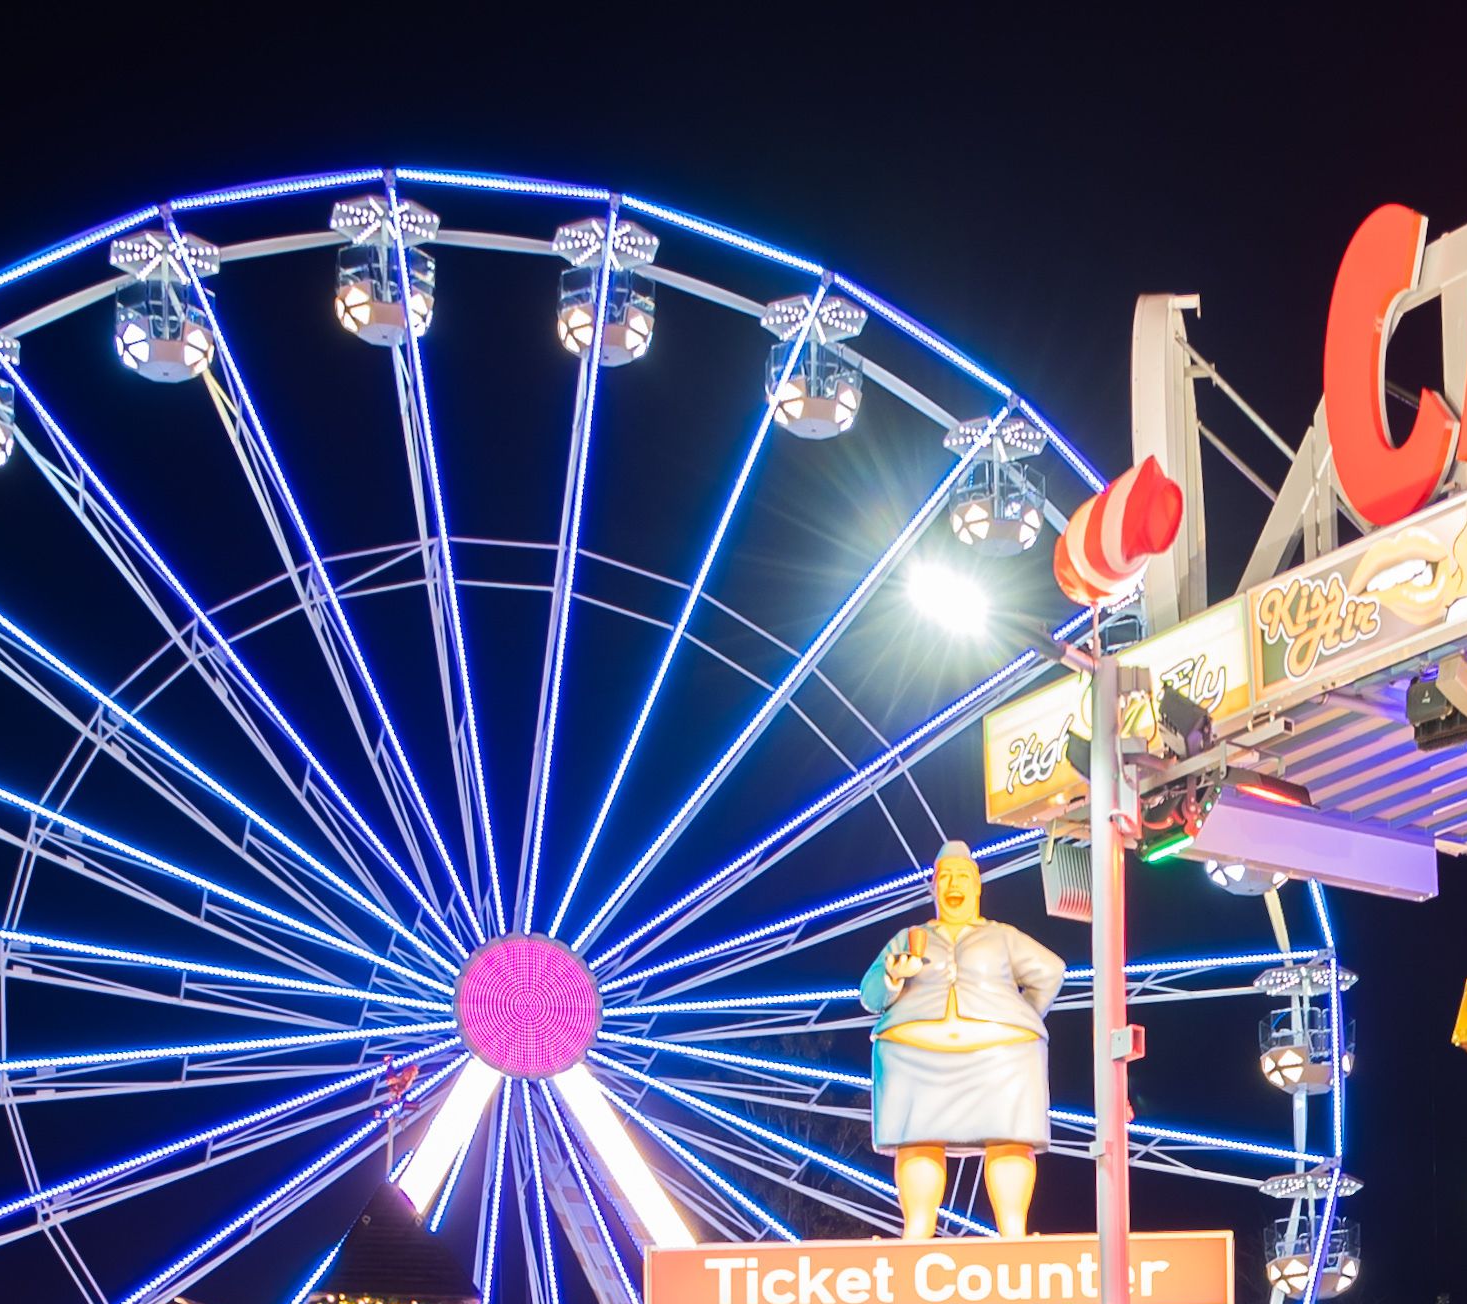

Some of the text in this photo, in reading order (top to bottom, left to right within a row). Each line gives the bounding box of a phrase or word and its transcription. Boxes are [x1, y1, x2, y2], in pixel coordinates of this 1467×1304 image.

[1259, 570, 1381, 682] Kiss Air
[915, 1252, 1169, 1303] Countr
